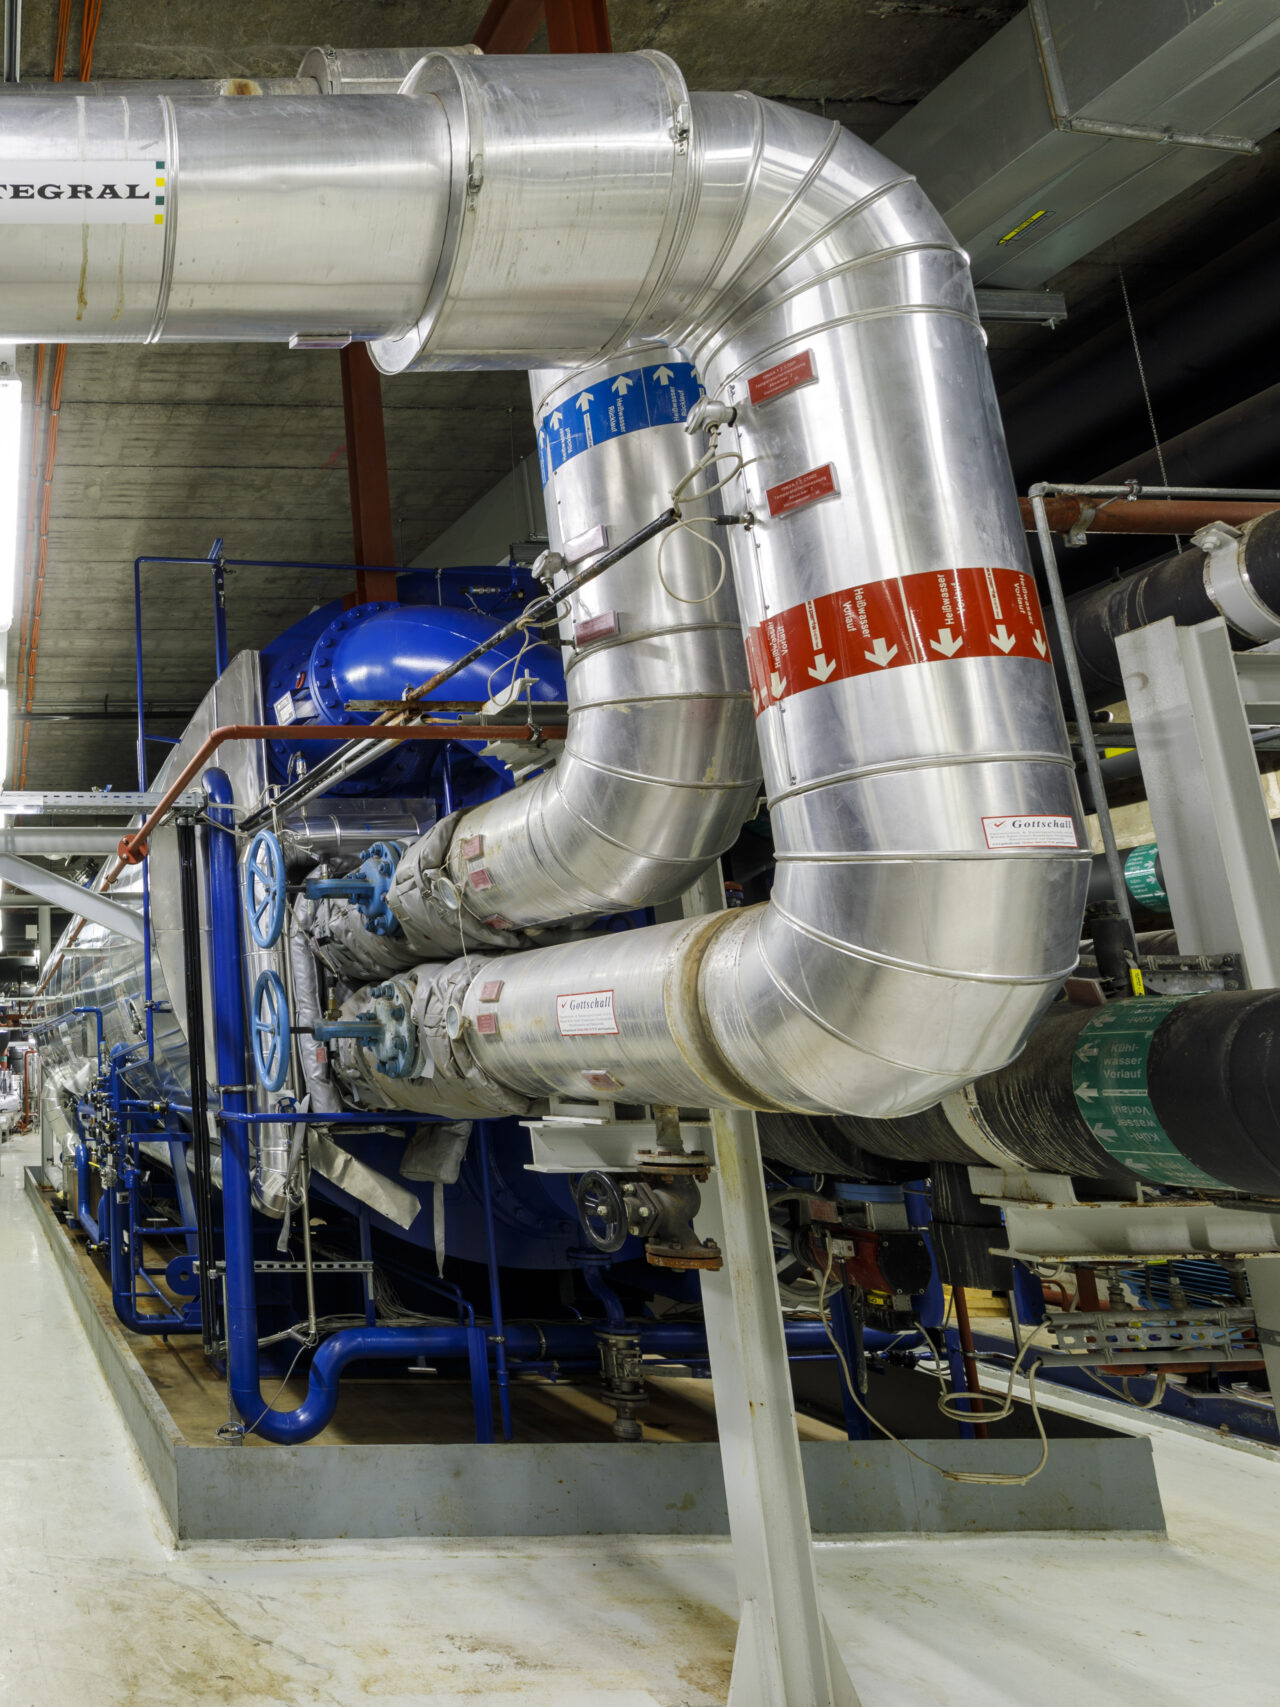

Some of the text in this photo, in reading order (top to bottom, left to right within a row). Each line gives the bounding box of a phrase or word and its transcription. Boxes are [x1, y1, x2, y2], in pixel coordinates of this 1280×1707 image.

[937, 573, 955, 625] Heißwasser
[1013, 582, 1026, 614] Vorlauf
[1018, 574, 1034, 625] Heißwasser
[842, 600, 857, 632] Vorlauf
[853, 587, 871, 638] Heißwasser
[1011, 819, 1071, 829] Gottschall
[569, 996, 611, 1011] Gottschall
[1110, 1042, 1139, 1053] Kühl-
[1103, 1057, 1142, 1066] wasser
[1103, 1069, 1142, 1079] Vorlauf
[1111, 1105, 1151, 1116] Vorlauf
[1118, 1118, 1157, 1128] wasser
